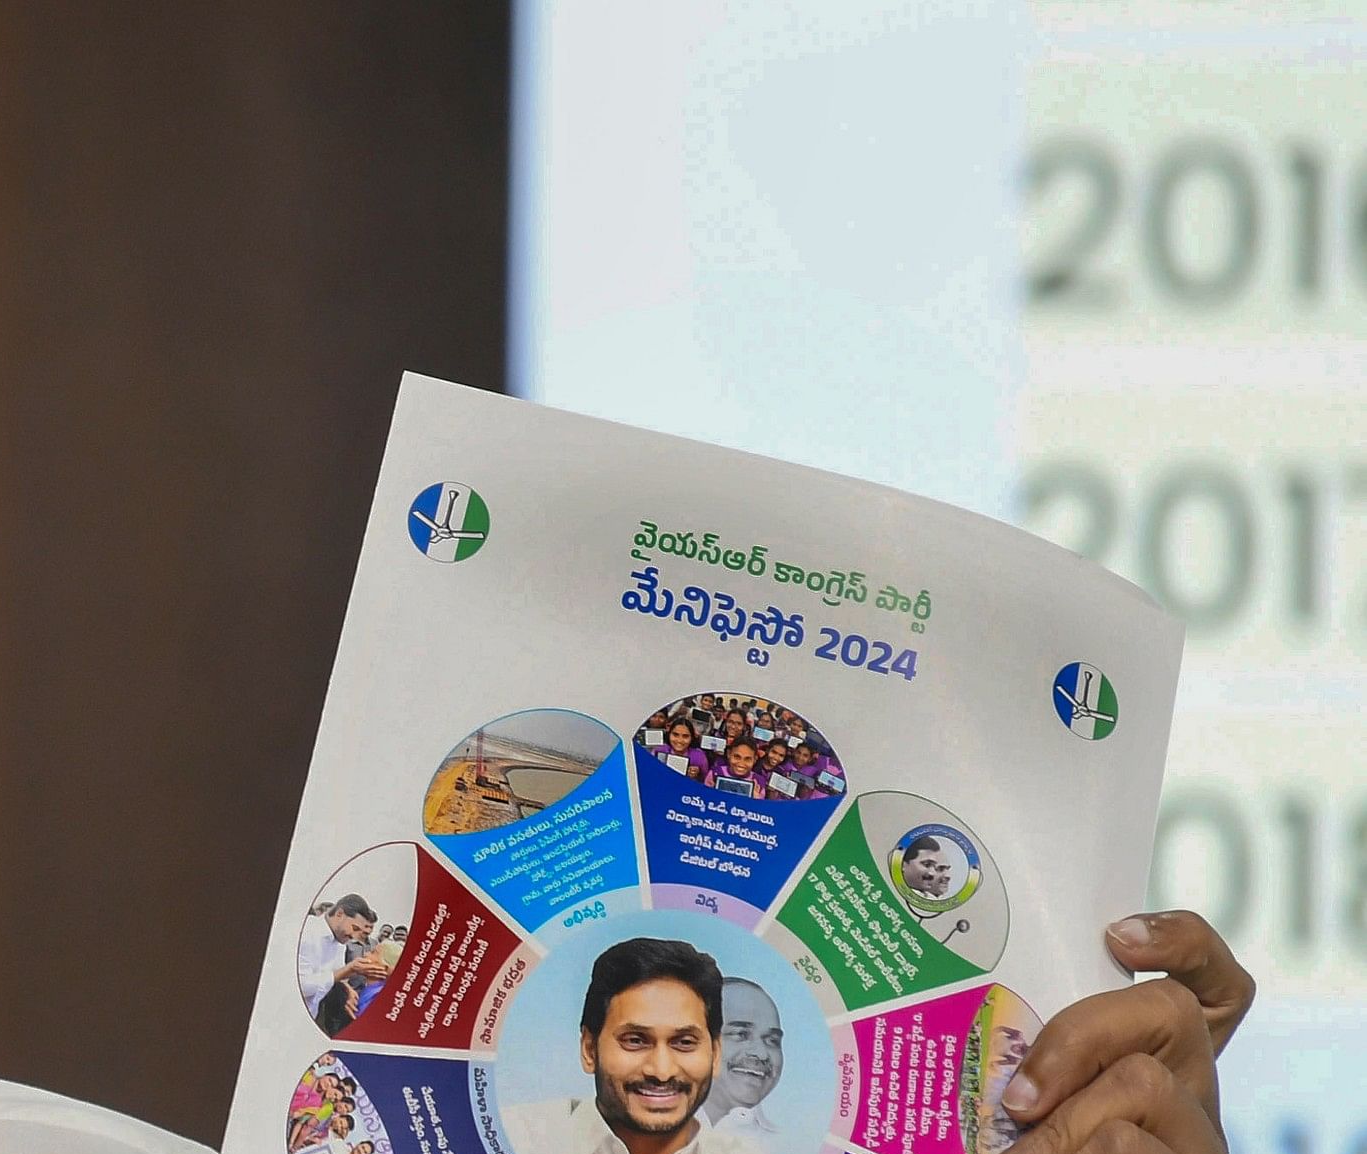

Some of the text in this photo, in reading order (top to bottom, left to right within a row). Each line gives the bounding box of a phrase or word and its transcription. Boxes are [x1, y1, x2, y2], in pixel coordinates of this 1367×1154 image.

[1018, 130, 1367, 312] 201
[773, 560, 868, 607] కాంగ్రెస్
[874, 584, 932, 634] పార్టీ
[621, 565, 918, 682] మేనిఫెస్టో 2024
[681, 794, 706, 813] అమ్మ
[680, 851, 751, 878] డిజిటల్ బోధన
[807, 872, 819, 882] 17
[695, 892, 719, 914] విద్య
[849, 865, 875, 896] ఆరోగ్య
[879, 902, 905, 933] ఆరోగ్య
[402, 962, 421, 992] కానుక
[413, 940, 432, 964] రెండు
[832, 936, 858, 967] ఆరోగ్య
[793, 954, 822, 984] వైద్యం
[480, 958, 527, 1045] సామాజిక భద్రత
[893, 1026, 903, 1034] 9
[890, 1036, 904, 1069] గంటల
[910, 1043, 922, 1067] పంట
[925, 1039, 937, 1068] ఉచిత
[473, 1067, 488, 1113] మహిళా
[839, 1053, 855, 1118] వ్యవసాయం
[888, 1071, 900, 1100] ఉచిత
[922, 1070, 936, 1105] పంటల
